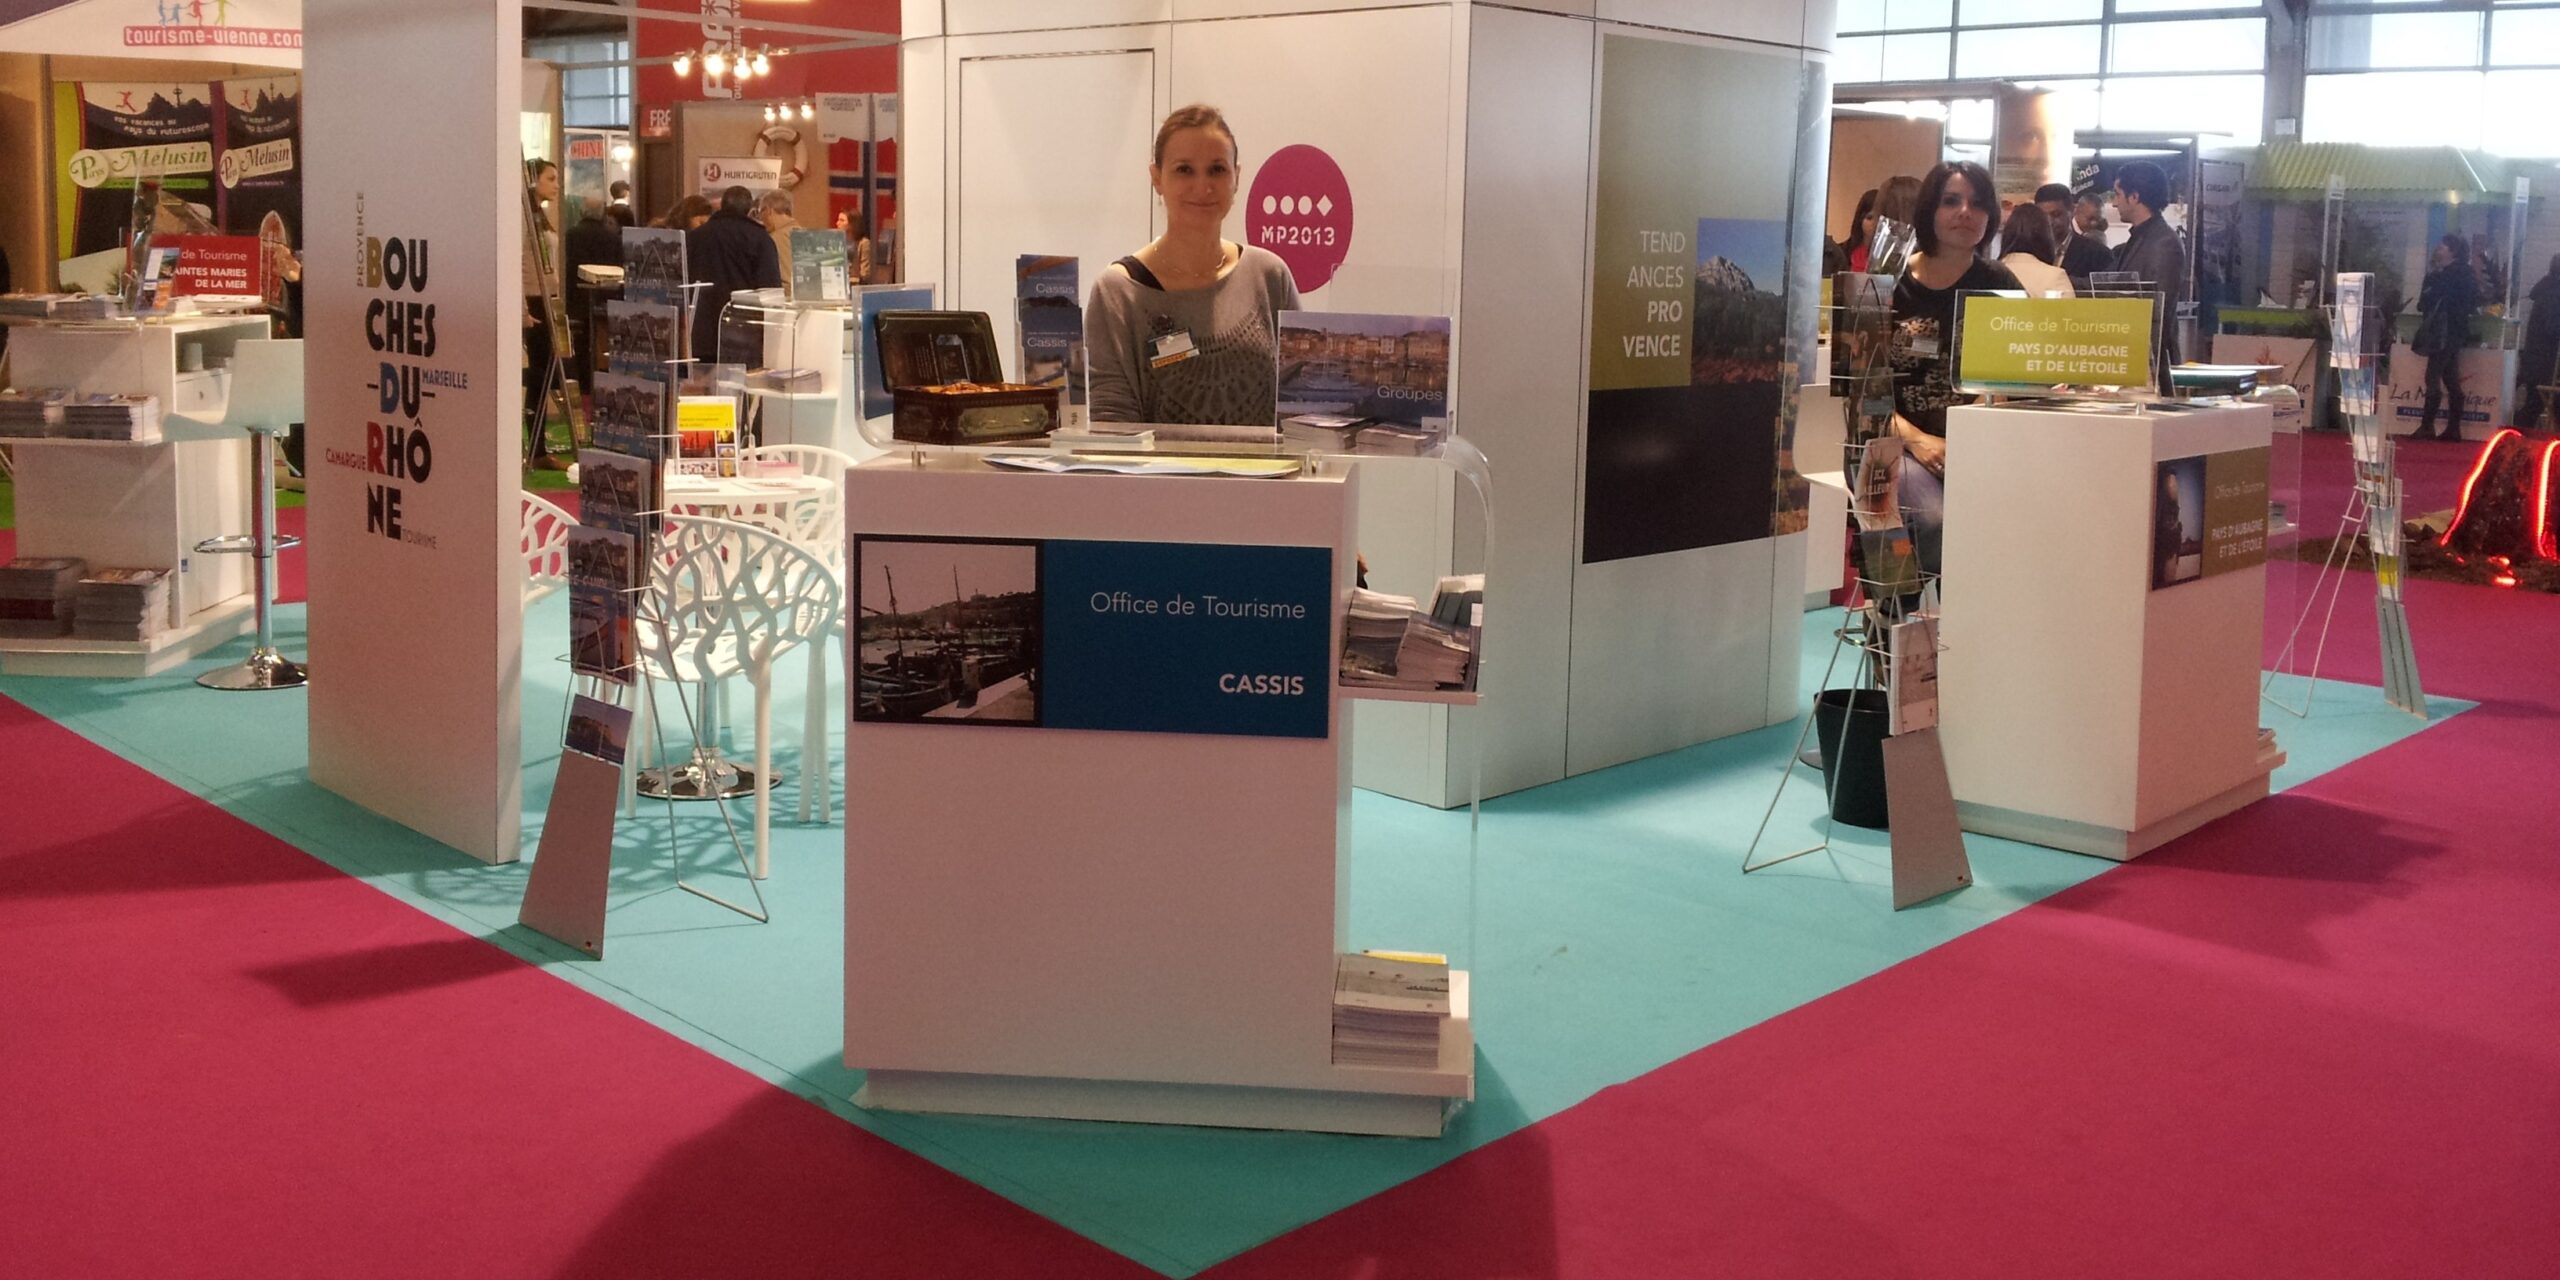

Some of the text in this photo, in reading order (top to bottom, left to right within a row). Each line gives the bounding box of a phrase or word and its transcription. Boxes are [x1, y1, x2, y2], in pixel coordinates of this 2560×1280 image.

[723, 170, 778, 181] HURTIGRUTEN
[356, 191, 365, 288] PROVENCE
[1261, 225, 1335, 246] MP2013
[1639, 229, 1686, 254] TEND
[181, 249, 248, 262] de Tourisme
[366, 236, 428, 293] BOU
[174, 266, 247, 278] AINTES MARIES
[1626, 265, 1684, 288] ANCES
[195, 278, 247, 290] DE LA MER
[1035, 282, 1076, 295] Cassis
[1647, 299, 1684, 323] PRO
[365, 297, 437, 358] CHES
[1990, 316, 2131, 335] Office de Tourisme
[1026, 337, 1069, 348] Cassis
[1622, 334, 1681, 358] VENCE
[2008, 343, 2129, 358] PAYS D'AUBAGNE
[2026, 359, 2041, 372] ET
[2046, 360, 2065, 373] DE
[421, 368, 468, 391] MARSEILLE
[1376, 385, 1444, 402] Groupes
[325, 447, 367, 471] CAMARGUE
[366, 417, 433, 484] RHÔ
[366, 481, 402, 541] NE
[1090, 591, 1306, 619] Office de Tourisme
[1219, 673, 1305, 696] CASSIS
